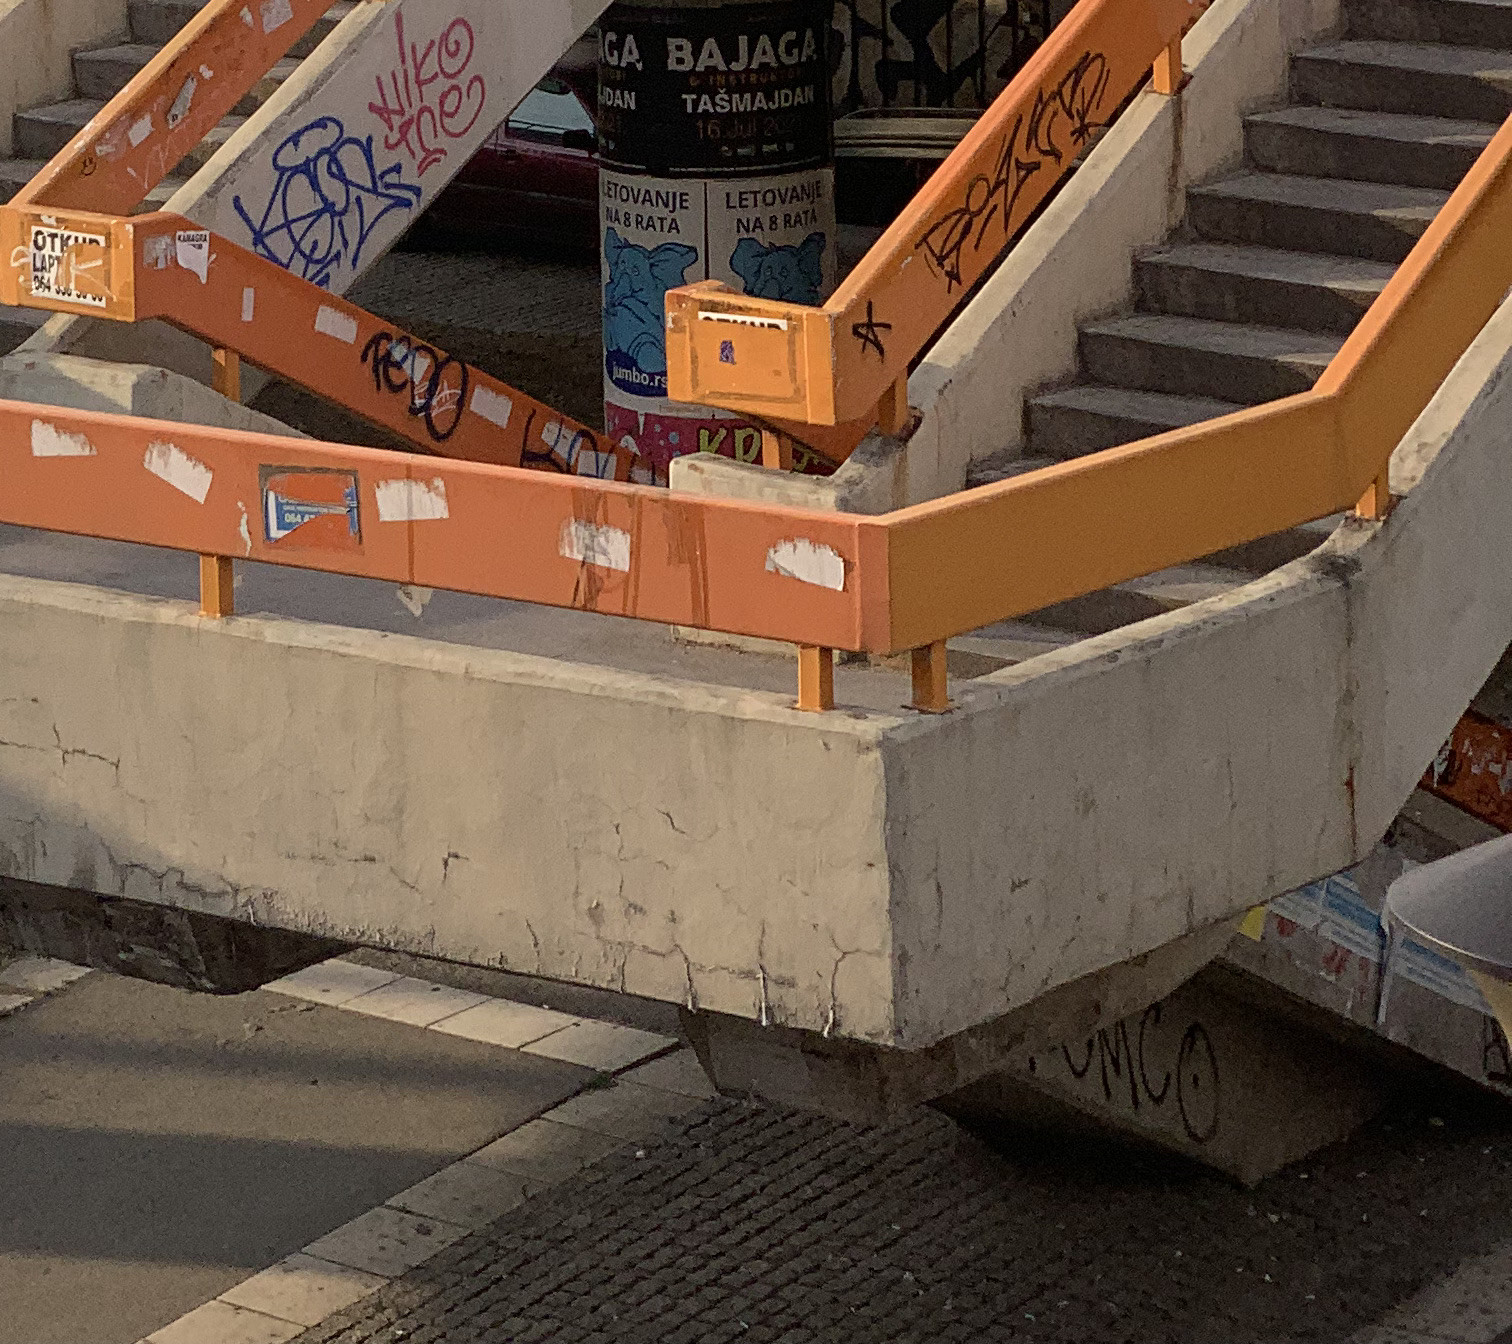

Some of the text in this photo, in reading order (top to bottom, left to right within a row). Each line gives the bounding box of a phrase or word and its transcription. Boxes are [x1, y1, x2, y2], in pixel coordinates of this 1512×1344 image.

[666, 27, 817, 72] BAJAGA
[681, 84, 815, 114] TAŠMAJDAN
[602, 180, 690, 213] LETOVANJE
[725, 179, 822, 210] LETOVANJE
[605, 206, 681, 234] NA 8 RATA
[736, 208, 818, 234] NA 8 RATA
[612, 362, 667, 389] jumbo.rs
